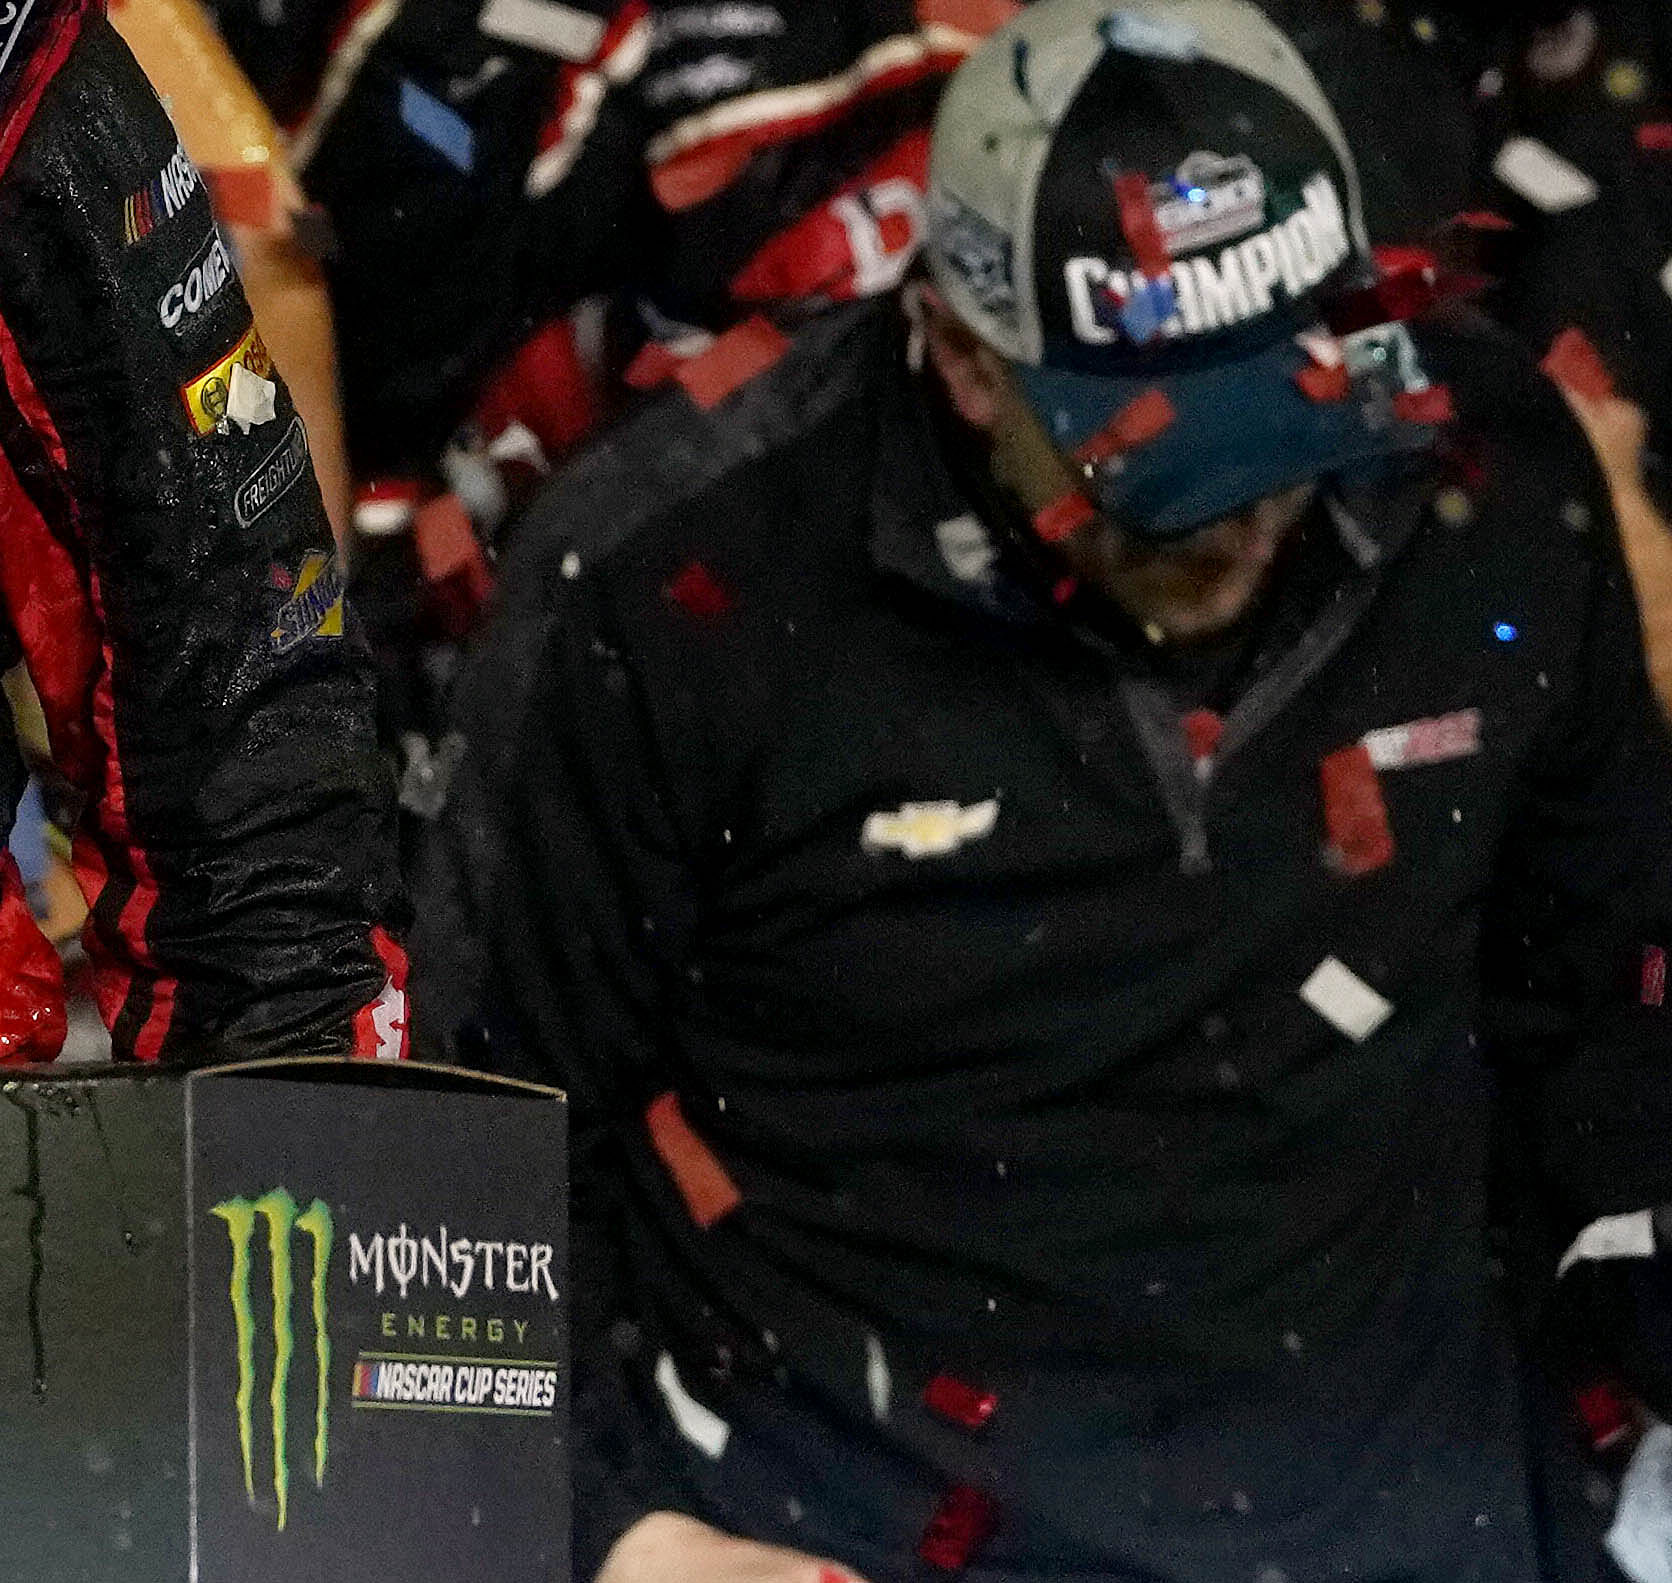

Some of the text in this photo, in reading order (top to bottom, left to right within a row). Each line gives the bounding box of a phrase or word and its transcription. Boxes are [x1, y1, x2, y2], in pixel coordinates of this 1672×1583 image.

[348, 1222, 560, 1301] MONSTER
[381, 1312, 530, 1344] ENERGY
[377, 1361, 558, 1408] NASCAR CUP SERIES
